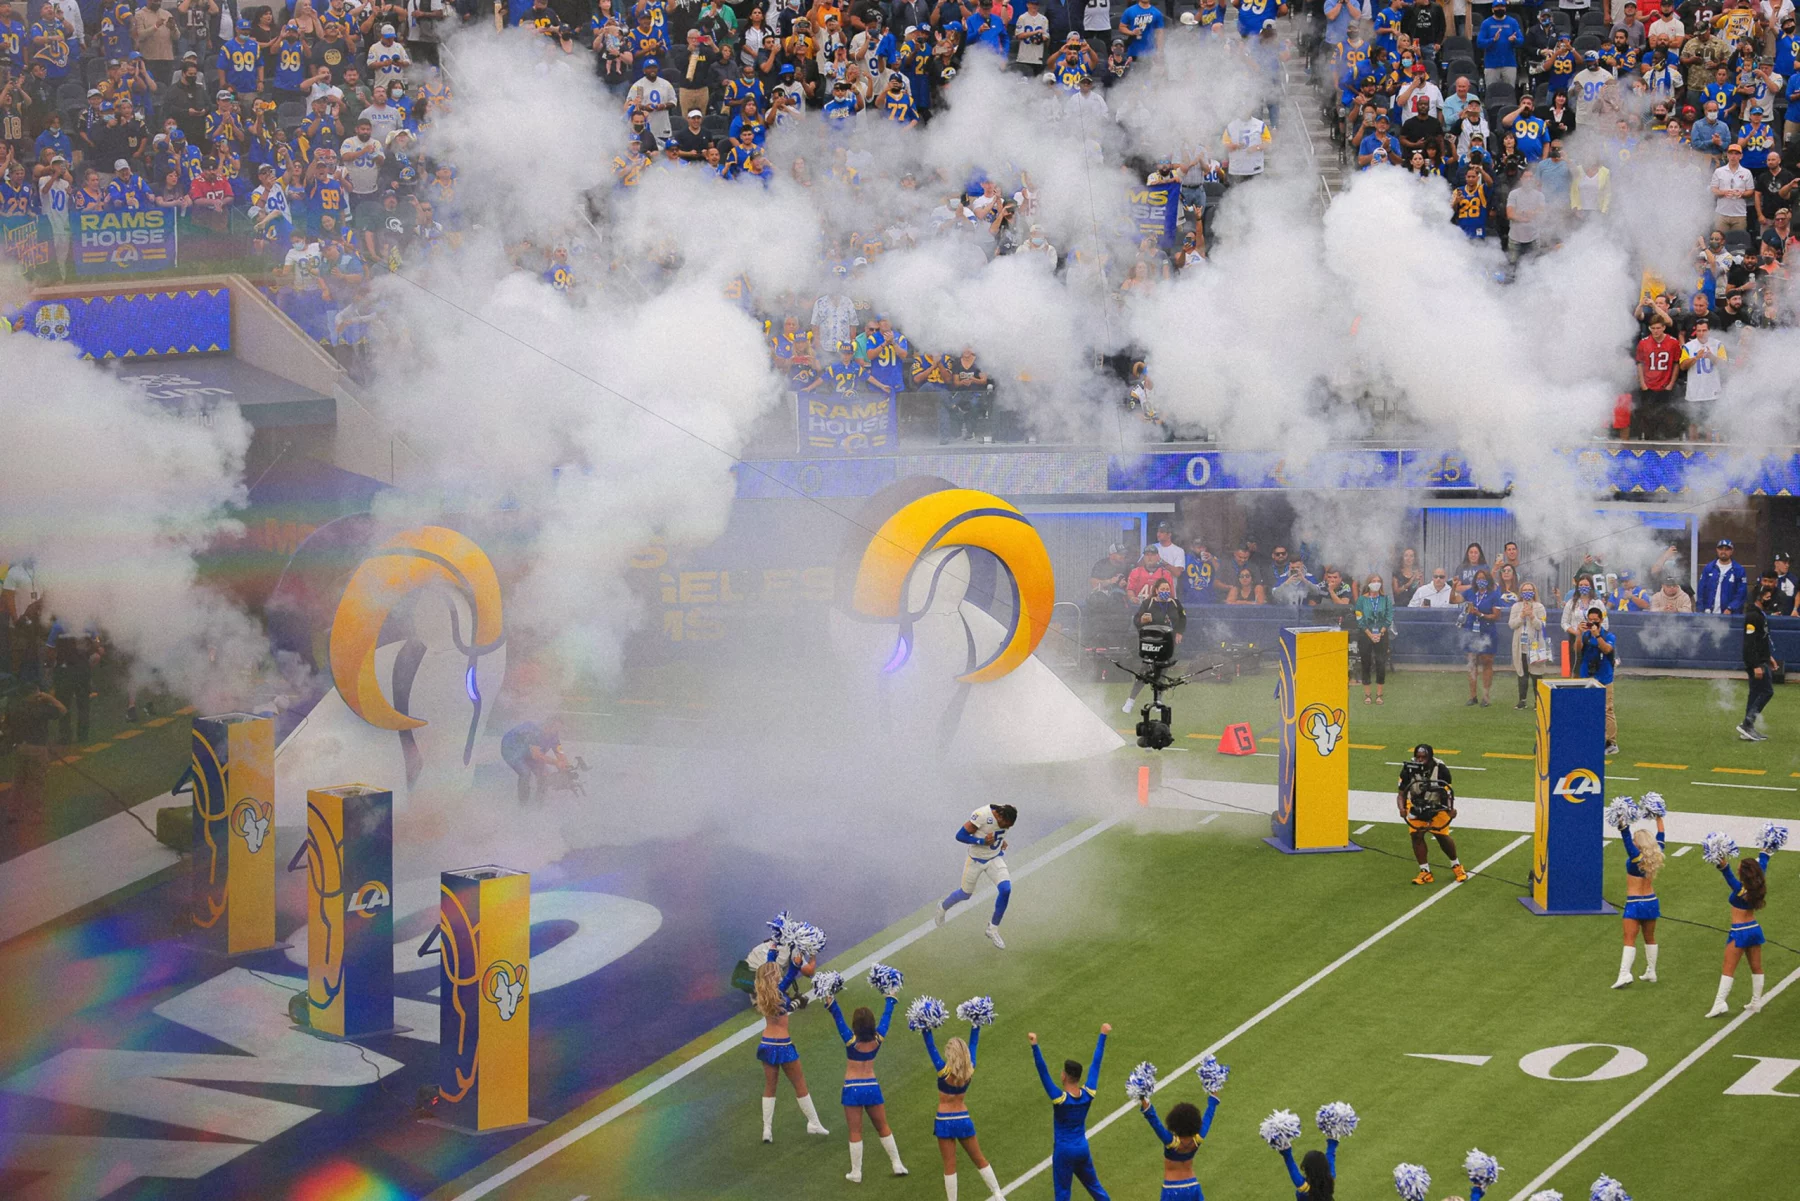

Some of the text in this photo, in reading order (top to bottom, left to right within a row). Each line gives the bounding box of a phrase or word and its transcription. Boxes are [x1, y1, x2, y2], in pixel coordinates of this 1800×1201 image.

[1134, 15, 1153, 26] RAMS
[233, 51, 255, 72] 99
[281, 50, 301, 71] 99
[869, 58, 879, 76] 9
[1554, 59, 1572, 75] 99
[1716, 92, 1727, 109] 9
[887, 103, 907, 121] 77
[4, 117, 22, 140] 18
[1515, 121, 1539, 139] 99
[8, 198, 27, 216] 29
[51, 189, 65, 212] 10
[321, 189, 340, 210] 99
[1458, 197, 1480, 219] 28
[81, 211, 165, 231] RAMS
[82, 229, 164, 248] HOUSE
[878, 344, 896, 367] 91
[1649, 352, 1669, 371] 12
[809, 398, 889, 419] RAMS
[809, 415, 888, 434] HOUSE
[1186, 456, 1211, 486] 0
[1234, 726, 1252, 750] G
[990, 829, 1005, 851] 5
